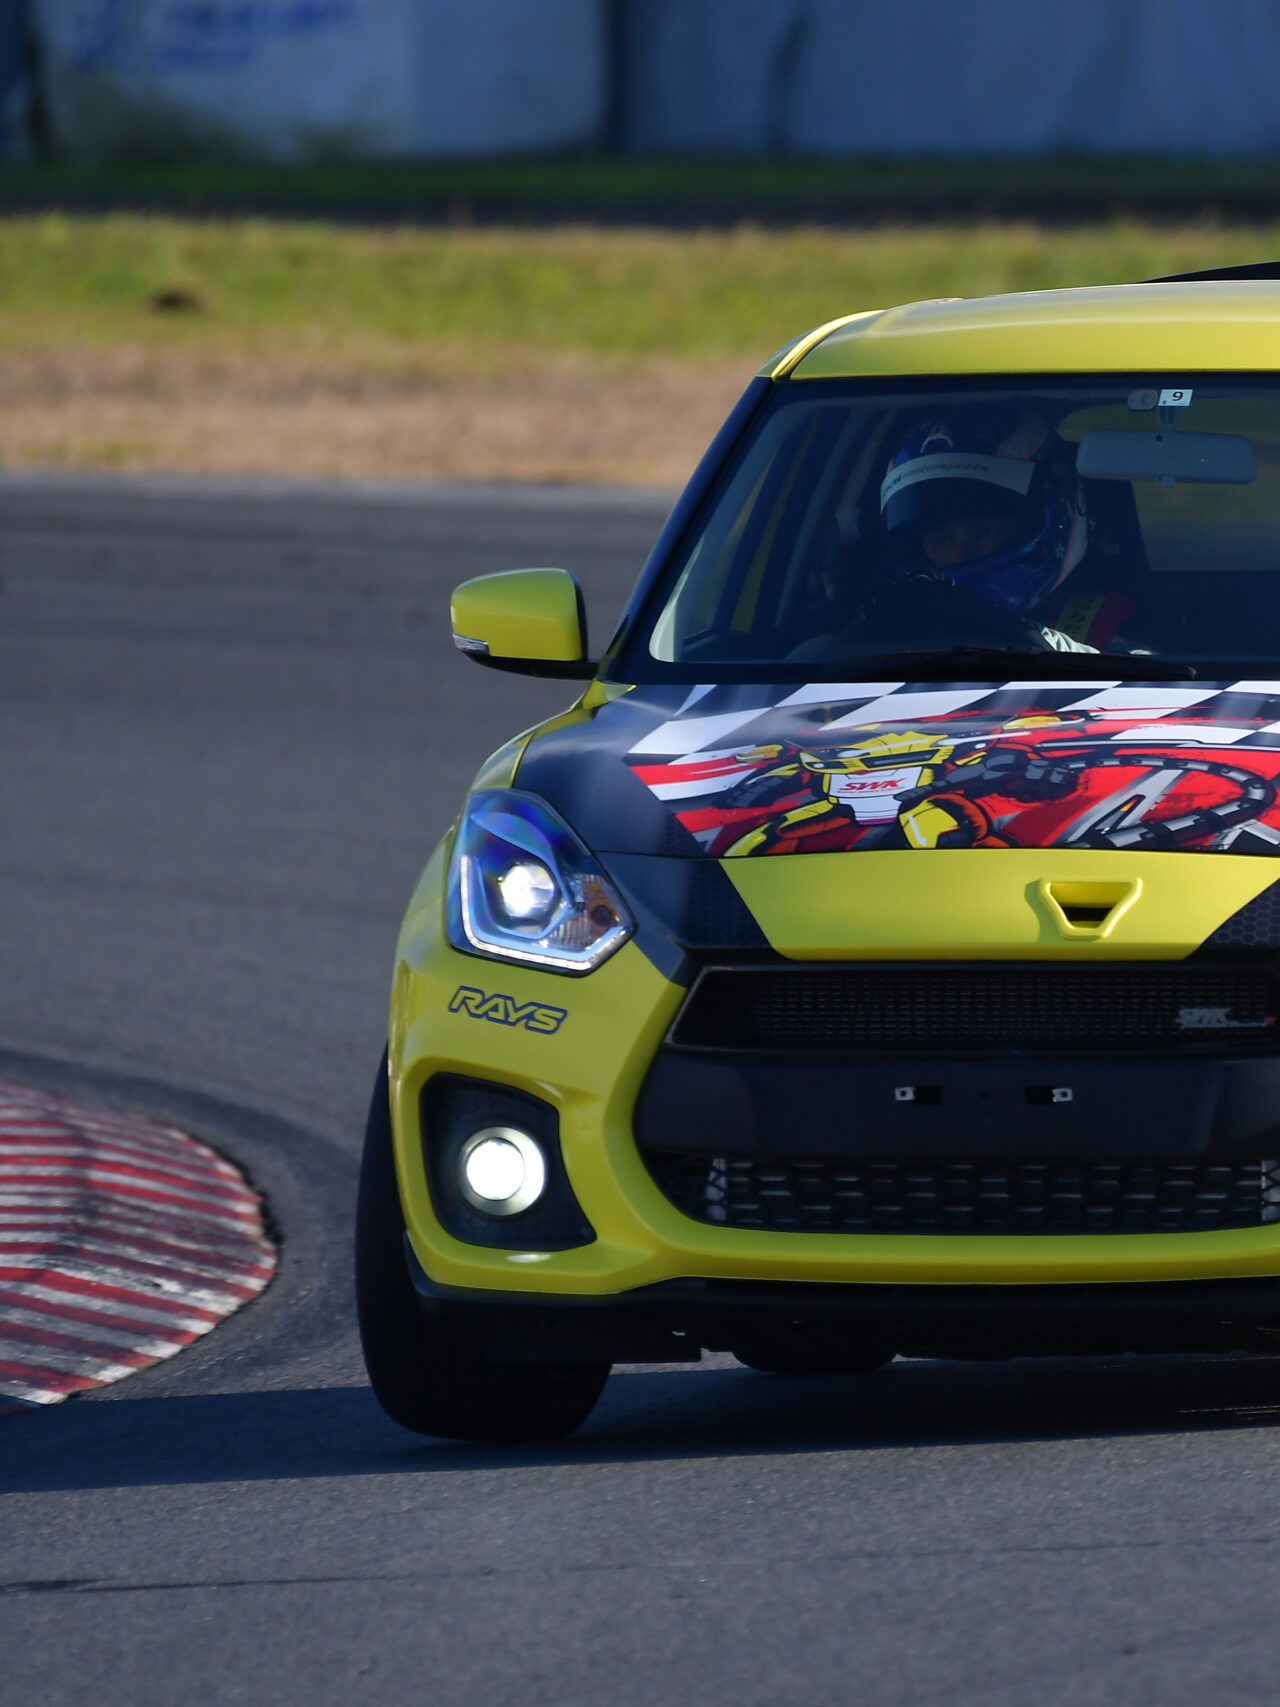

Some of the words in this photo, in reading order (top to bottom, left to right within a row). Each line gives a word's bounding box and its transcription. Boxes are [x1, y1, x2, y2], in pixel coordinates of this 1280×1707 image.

[1172, 391, 1184, 402] 9
[839, 778, 906, 791] SWK
[448, 985, 568, 1035] RAYS
